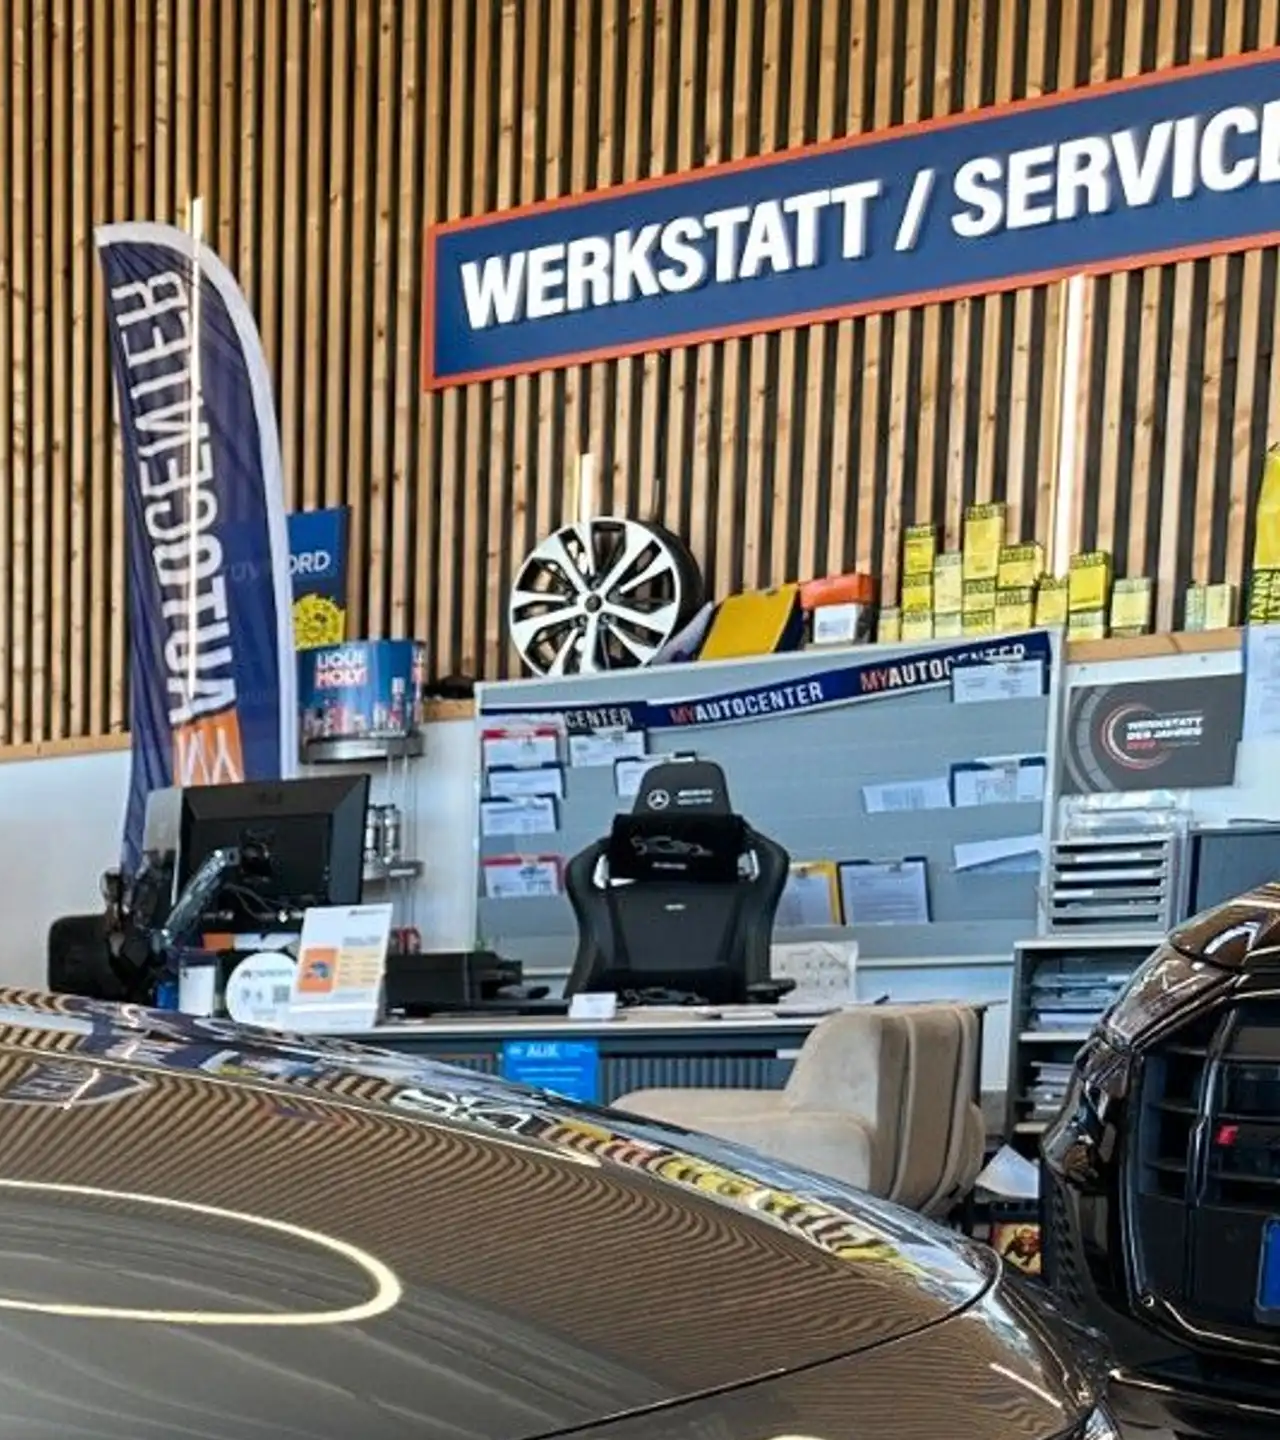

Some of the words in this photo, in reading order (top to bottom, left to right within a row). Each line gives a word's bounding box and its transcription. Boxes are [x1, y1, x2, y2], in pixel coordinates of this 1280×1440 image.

[460, 178, 880, 330] WERKSTATT
[894, 168, 936, 252] /
[287, 549, 332, 577] ORD
[669, 681, 824, 724] MYAUTOCENTER
